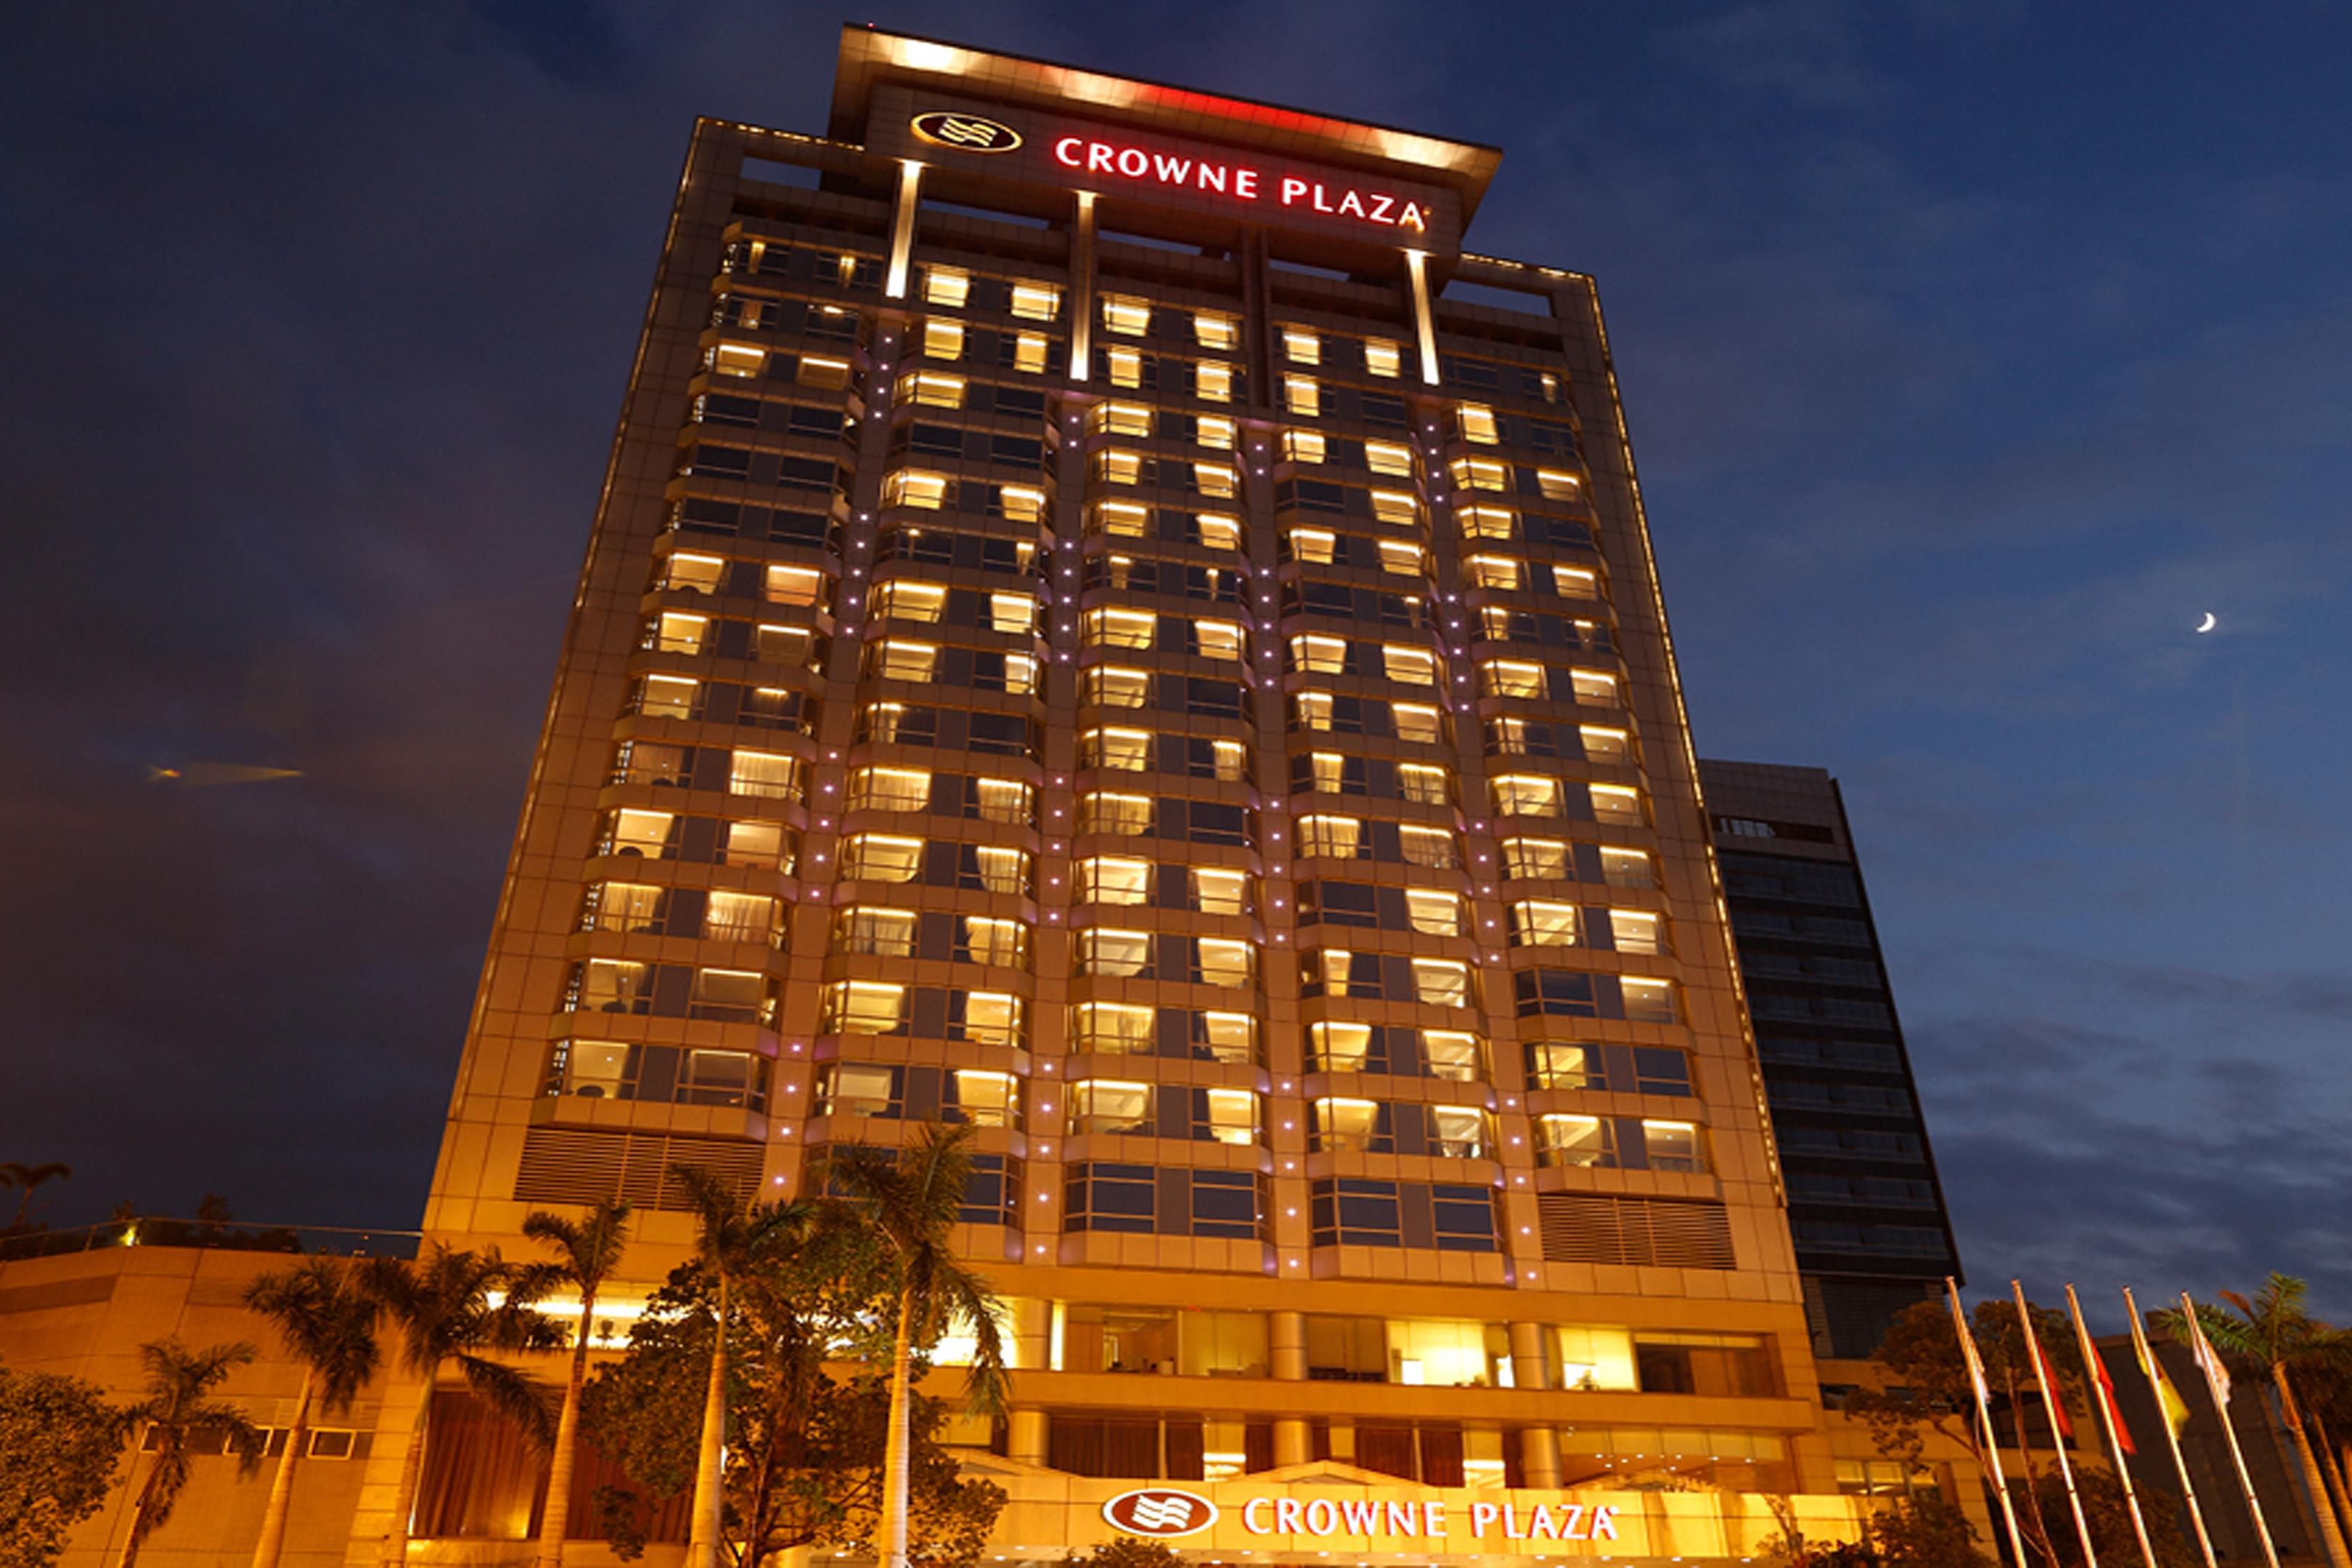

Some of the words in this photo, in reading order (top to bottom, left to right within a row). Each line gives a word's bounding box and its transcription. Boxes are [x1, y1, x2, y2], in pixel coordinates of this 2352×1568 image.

[1055, 137, 1259, 198] CROWNE
[1282, 178, 1425, 232] PLAZA
[1244, 1498, 1447, 1537] CROWNE
[1471, 1503, 1619, 1540] PLAZA
